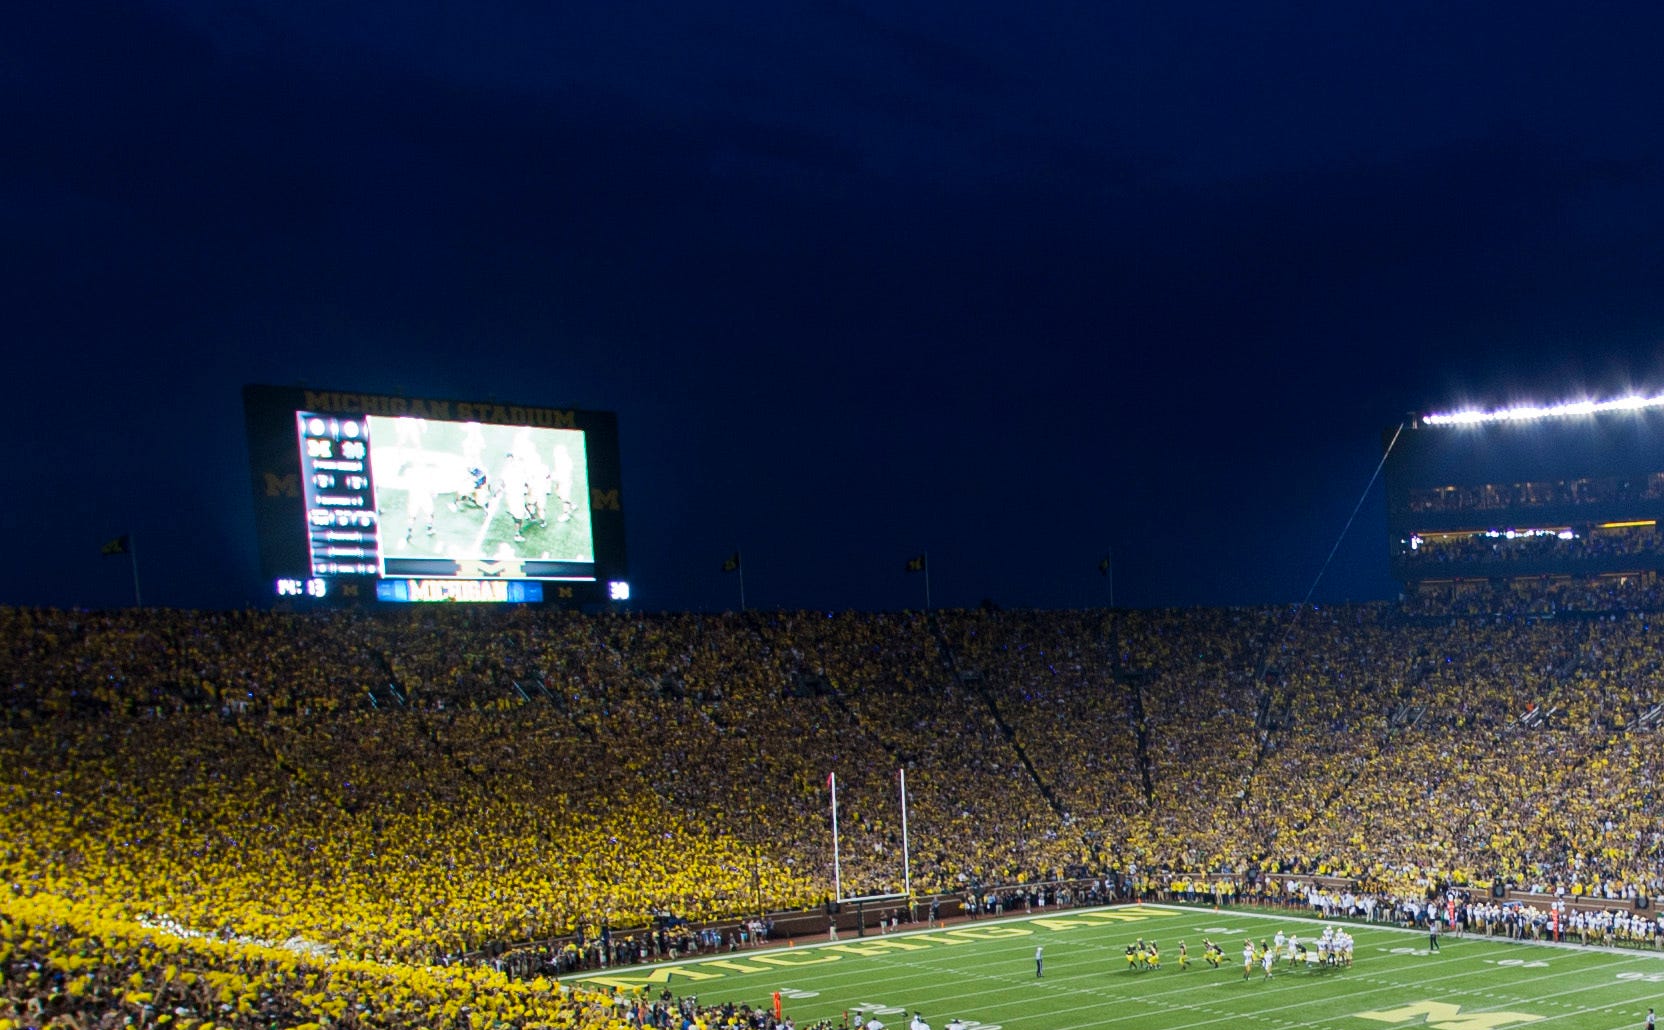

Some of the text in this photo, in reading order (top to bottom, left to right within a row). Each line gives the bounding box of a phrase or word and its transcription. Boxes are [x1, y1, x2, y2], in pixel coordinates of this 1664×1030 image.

[303, 389, 576, 429] MICHIGAN STADIUM
[263, 472, 298, 497] M
[591, 487, 621, 512] M
[408, 580, 509, 601] MICHIGAN
[576, 907, 1184, 990] MICHIGAN
